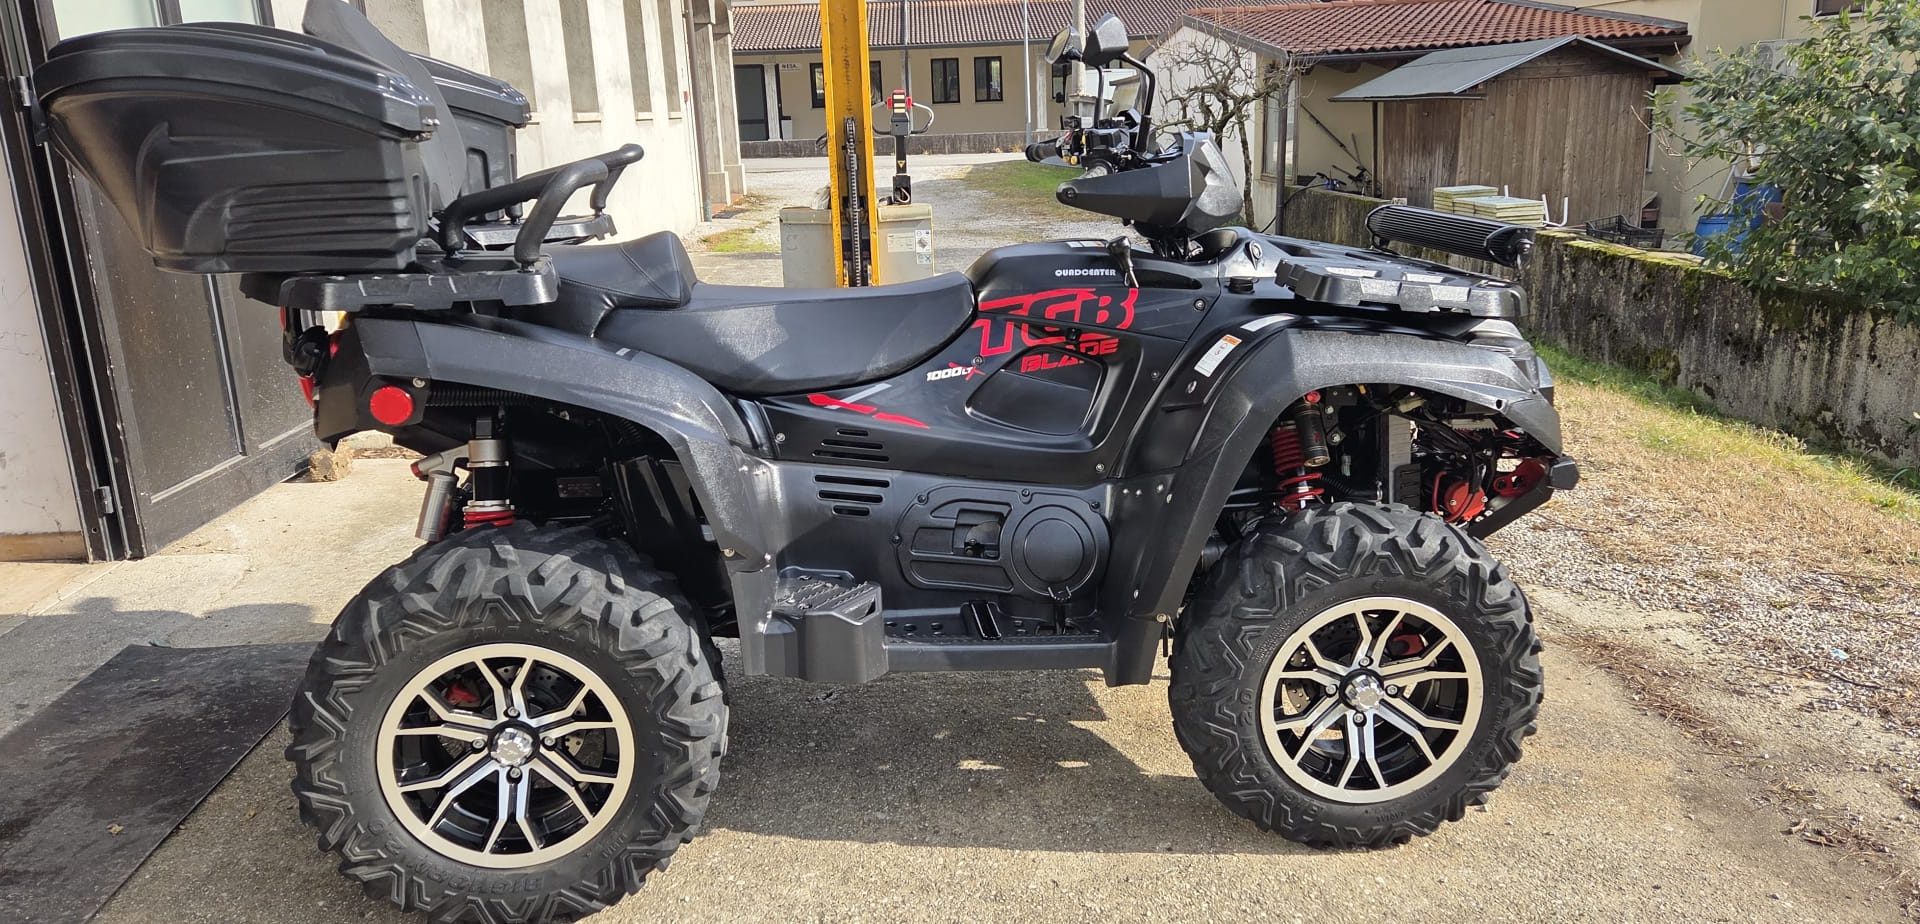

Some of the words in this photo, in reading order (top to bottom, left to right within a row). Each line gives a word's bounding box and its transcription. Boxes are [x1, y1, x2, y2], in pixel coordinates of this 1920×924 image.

[1055, 268, 1116, 277] QUADCENTER
[971, 287, 1139, 357] TGB
[1020, 338, 1120, 374] BLADE
